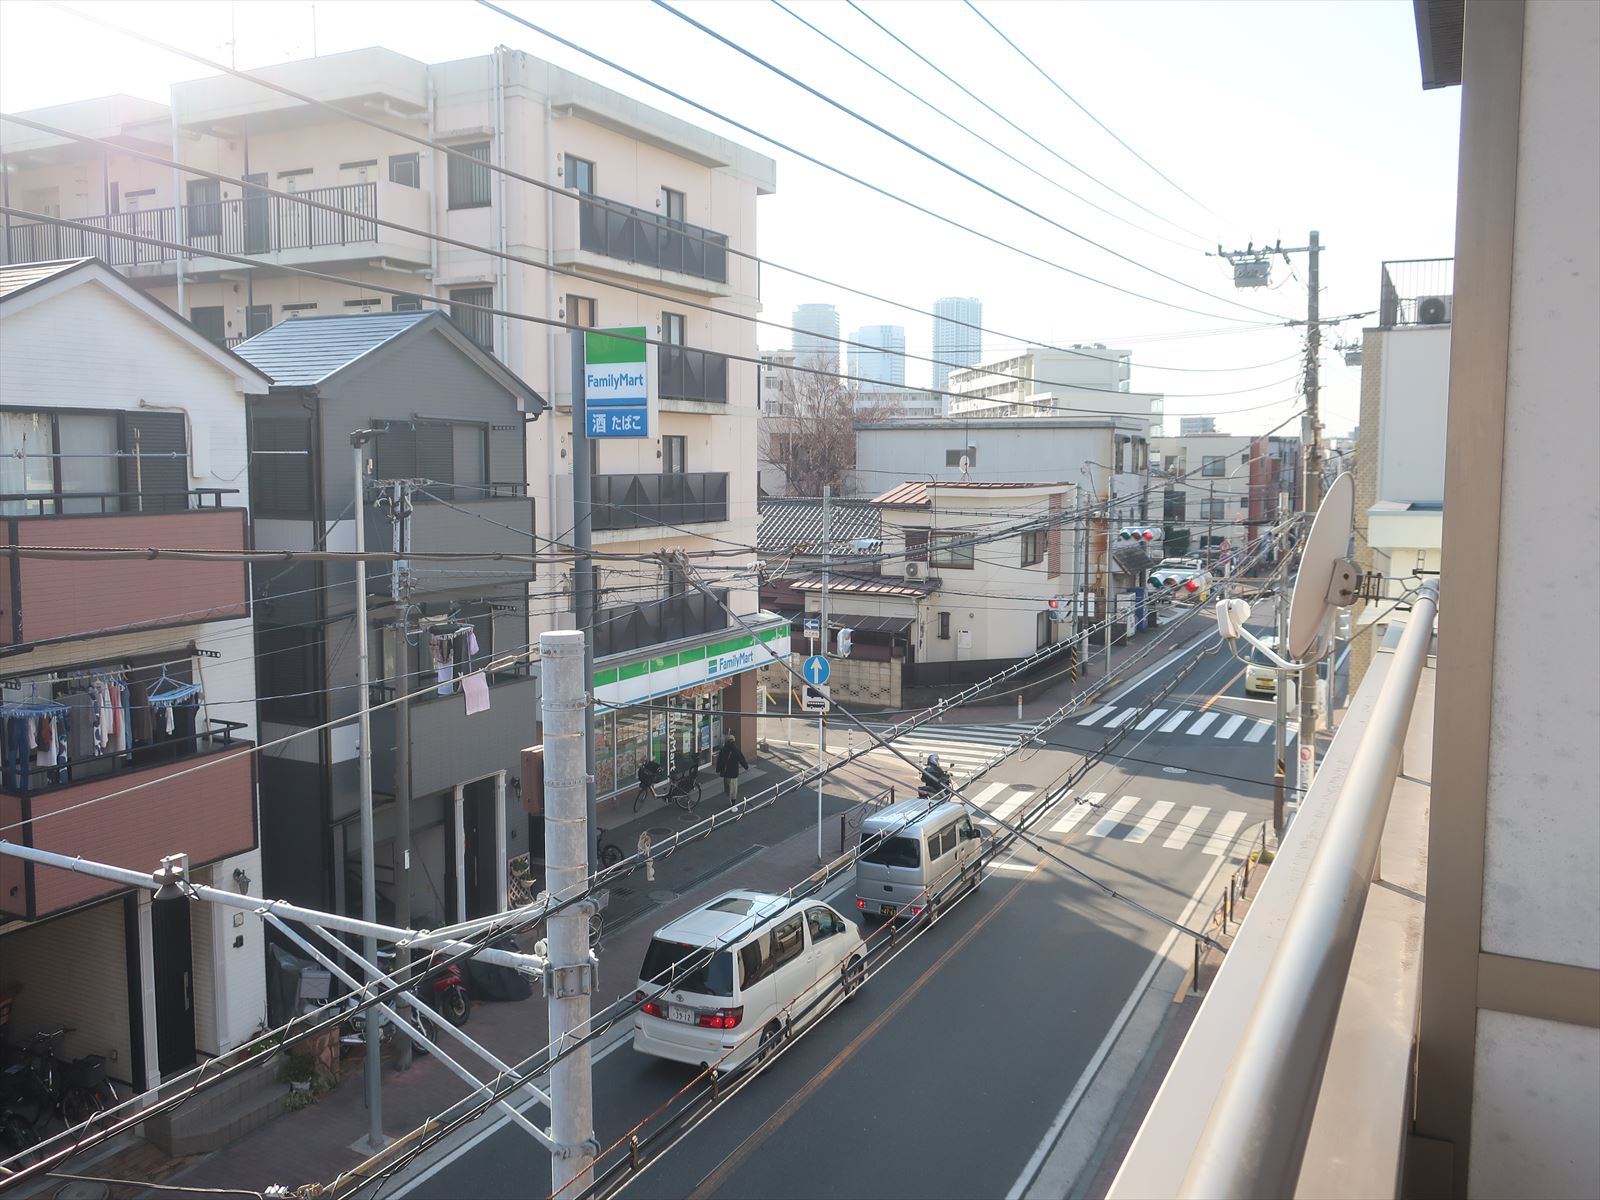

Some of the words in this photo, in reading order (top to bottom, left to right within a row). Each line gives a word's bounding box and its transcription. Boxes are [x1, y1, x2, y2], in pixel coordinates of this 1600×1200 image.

[587, 373, 644, 390] FamilyMart
[592, 413, 606, 433] 酒
[611, 415, 641, 430] たばこ
[719, 651, 753, 671] FamilyMart
[669, 697, 677, 772] FmilyMart
